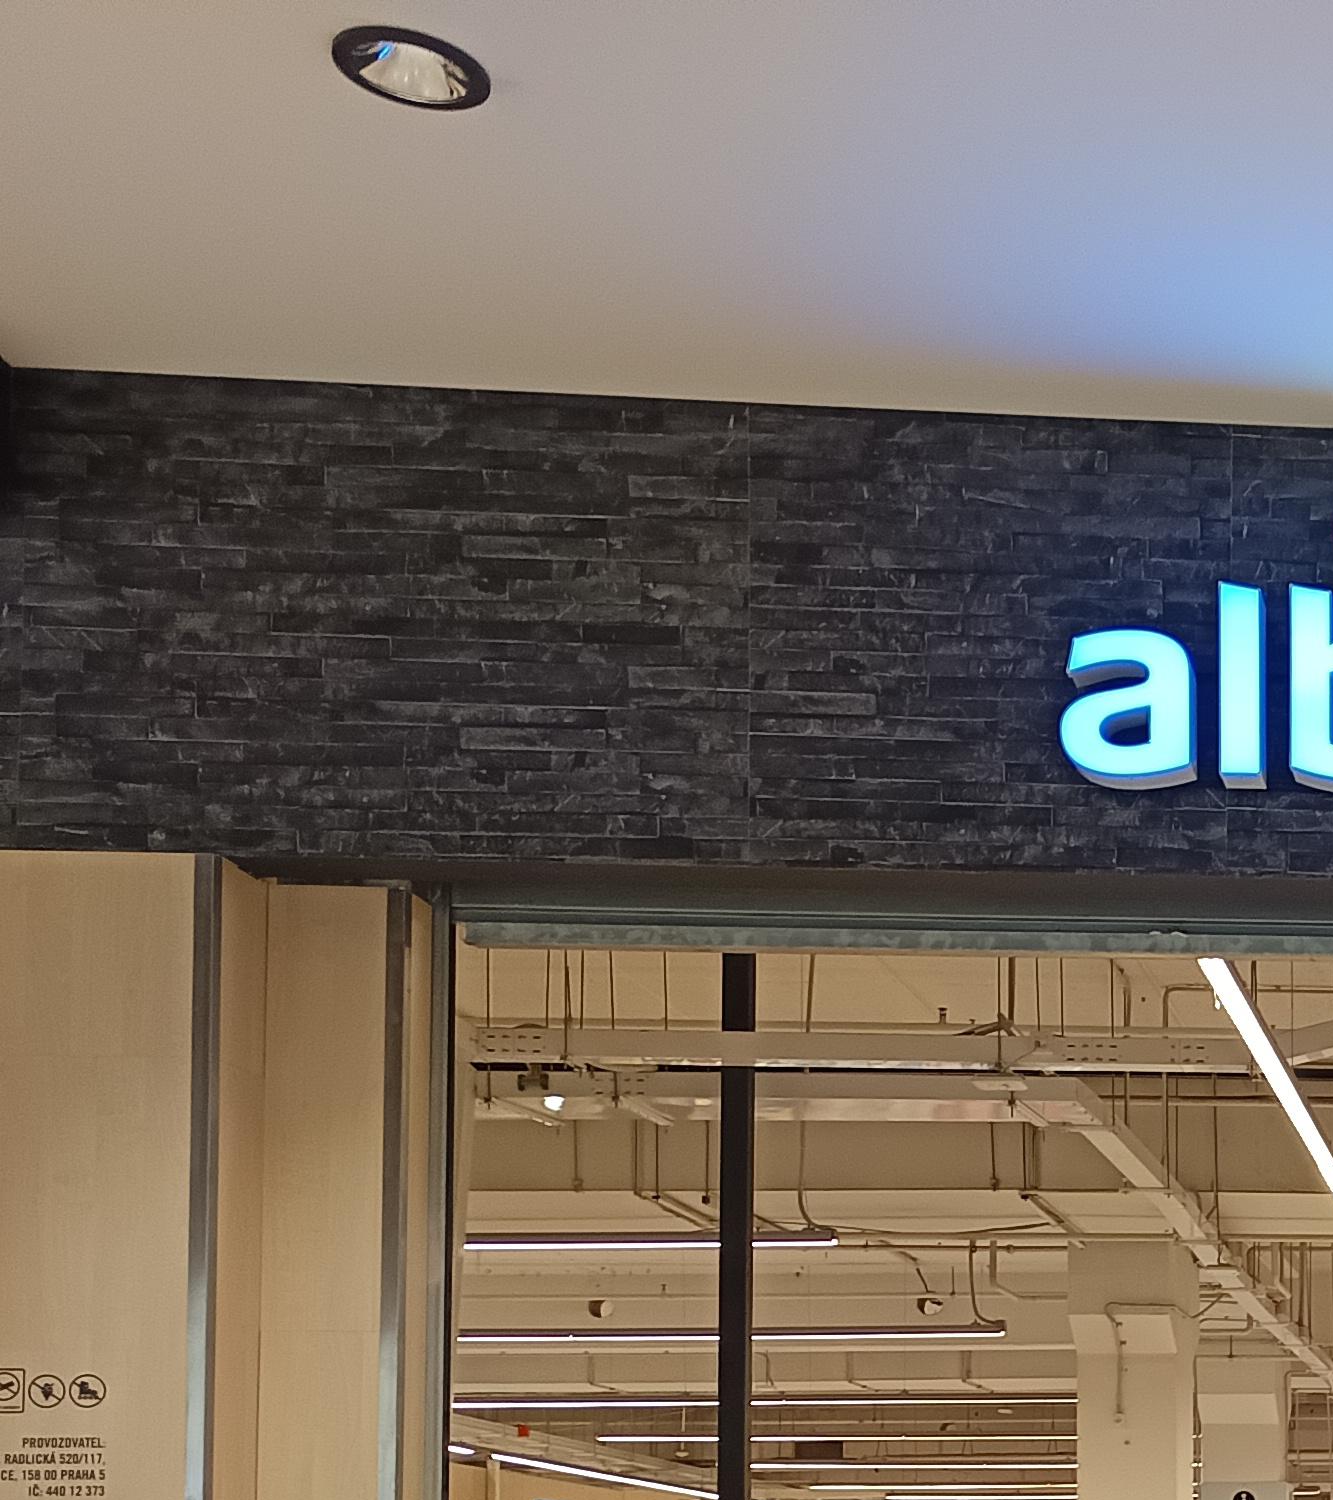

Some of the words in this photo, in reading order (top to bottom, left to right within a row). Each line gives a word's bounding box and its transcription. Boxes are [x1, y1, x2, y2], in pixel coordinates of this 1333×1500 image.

[22, 1437, 106, 1449] PROVOZOVATEL:
[4, 1451, 56, 1465] RADLICKÁ
[59, 1453, 106, 1466] 520/117,
[22, 1469, 41, 1481] 158
[44, 1469, 57, 1481] 00
[60, 1469, 96, 1481] PRAHA
[99, 1469, 106, 1481] 5
[28, 1484, 43, 1497] IČ:
[46, 1486, 66, 1497] 440
[70, 1486, 82, 1496] 12
[85, 1486, 105, 1497] 373
